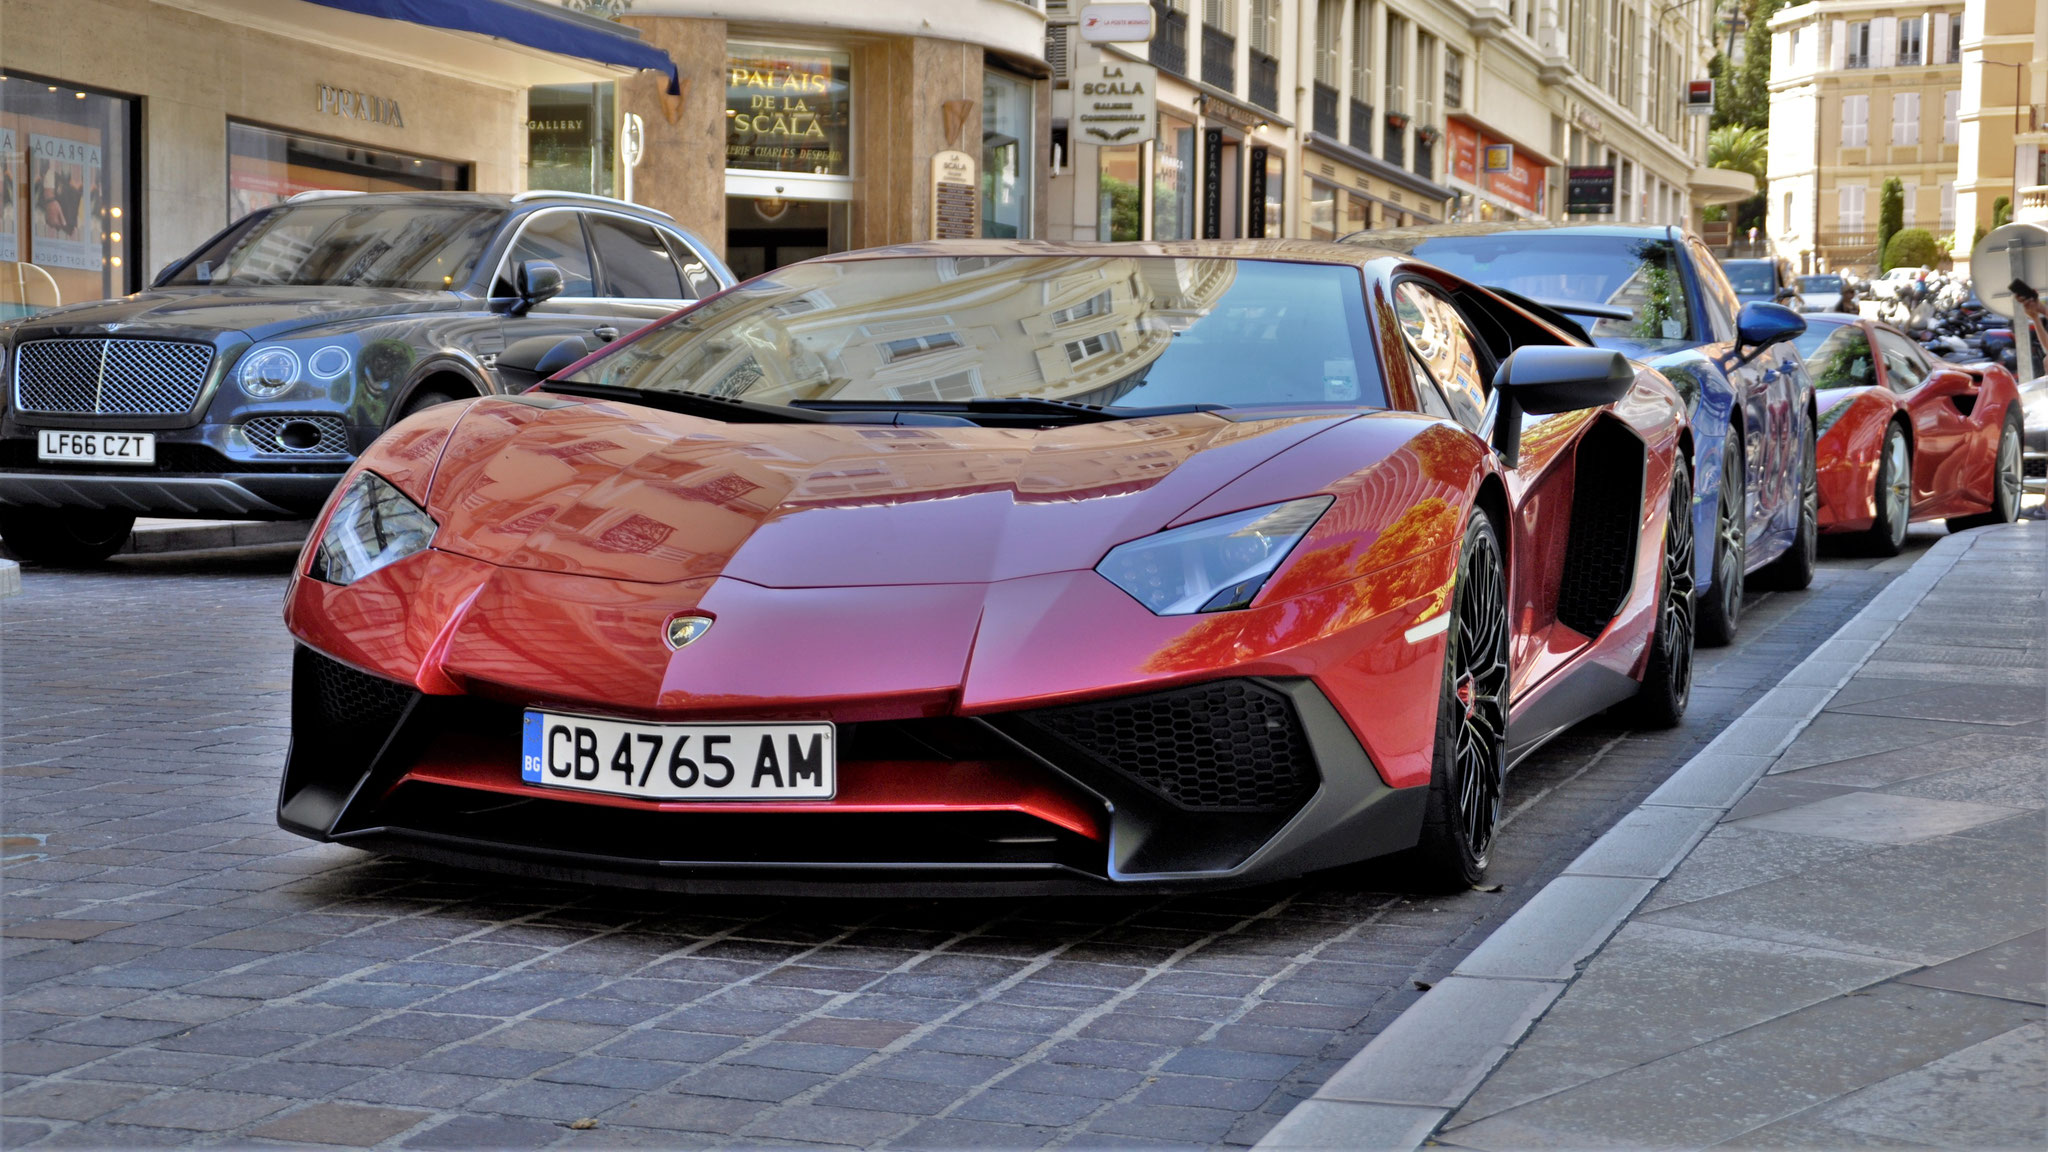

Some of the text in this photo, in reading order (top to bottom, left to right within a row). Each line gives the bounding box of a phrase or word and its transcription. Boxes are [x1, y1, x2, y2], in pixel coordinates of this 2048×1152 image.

[731, 68, 825, 93] PALAIS
[1103, 66, 1123, 78] LA
[1083, 82, 1144, 95] SCALA
[316, 83, 404, 128] PRADA
[751, 94, 808, 112] DE LA
[528, 120, 583, 130] GALLERY
[735, 113, 824, 137] SCALA
[755, 146, 796, 159] CHARLES
[1208, 133, 1218, 177] OPERA
[47, 433, 145, 457] LF66 CZT
[524, 755, 541, 772] BG
[549, 724, 822, 788] CB 4765 AM
